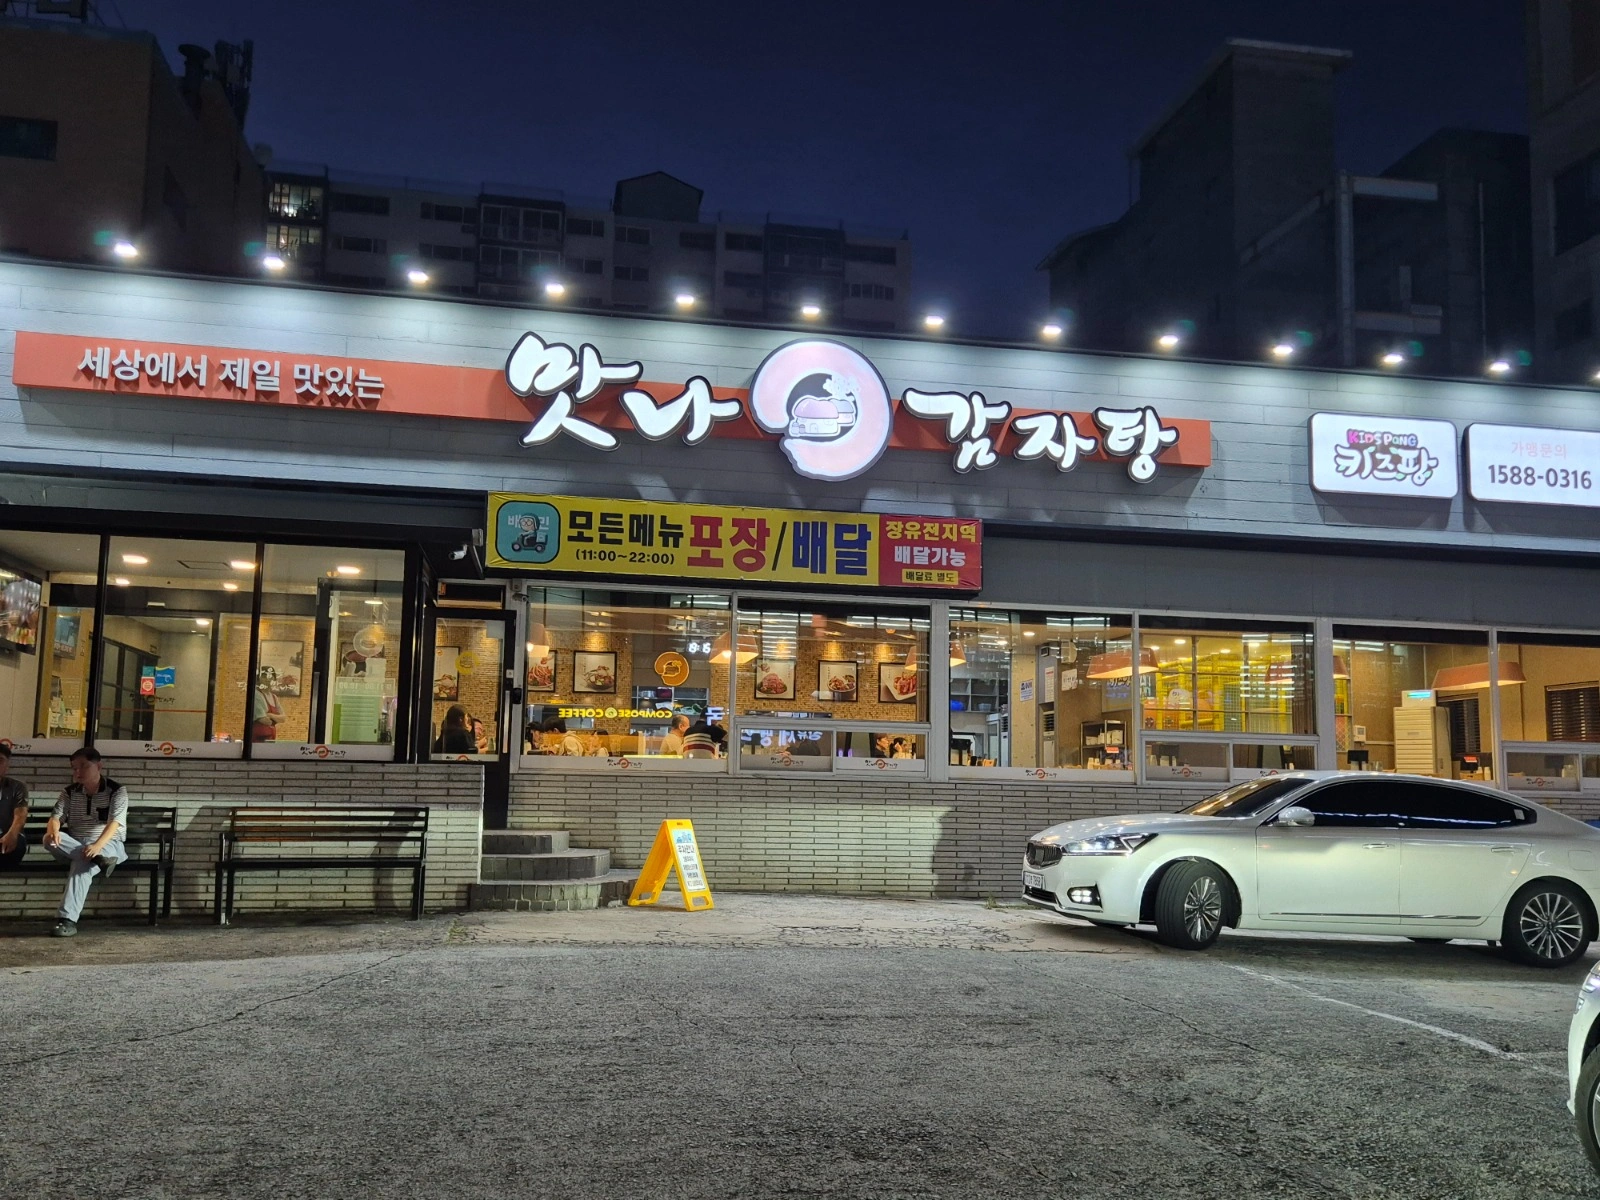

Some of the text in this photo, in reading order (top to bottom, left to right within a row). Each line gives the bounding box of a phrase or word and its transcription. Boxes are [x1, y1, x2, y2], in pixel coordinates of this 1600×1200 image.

[78, 347, 385, 399] 세상에서 제일 맛있는
[507, 332, 1179, 482] 맛나 감자탕
[1347, 428, 1382, 445] KIDS
[1511, 441, 1567, 458] 가맹문의
[1334, 444, 1439, 487] 키즈팡
[1488, 464, 1592, 489] 1588-0316
[567, 510, 872, 576] 모든메뉴 포장/배달
[885, 521, 976, 542] 장유전지역
[576, 549, 675, 565] (11:00~22:00)
[894, 545, 966, 567] 배달가능
